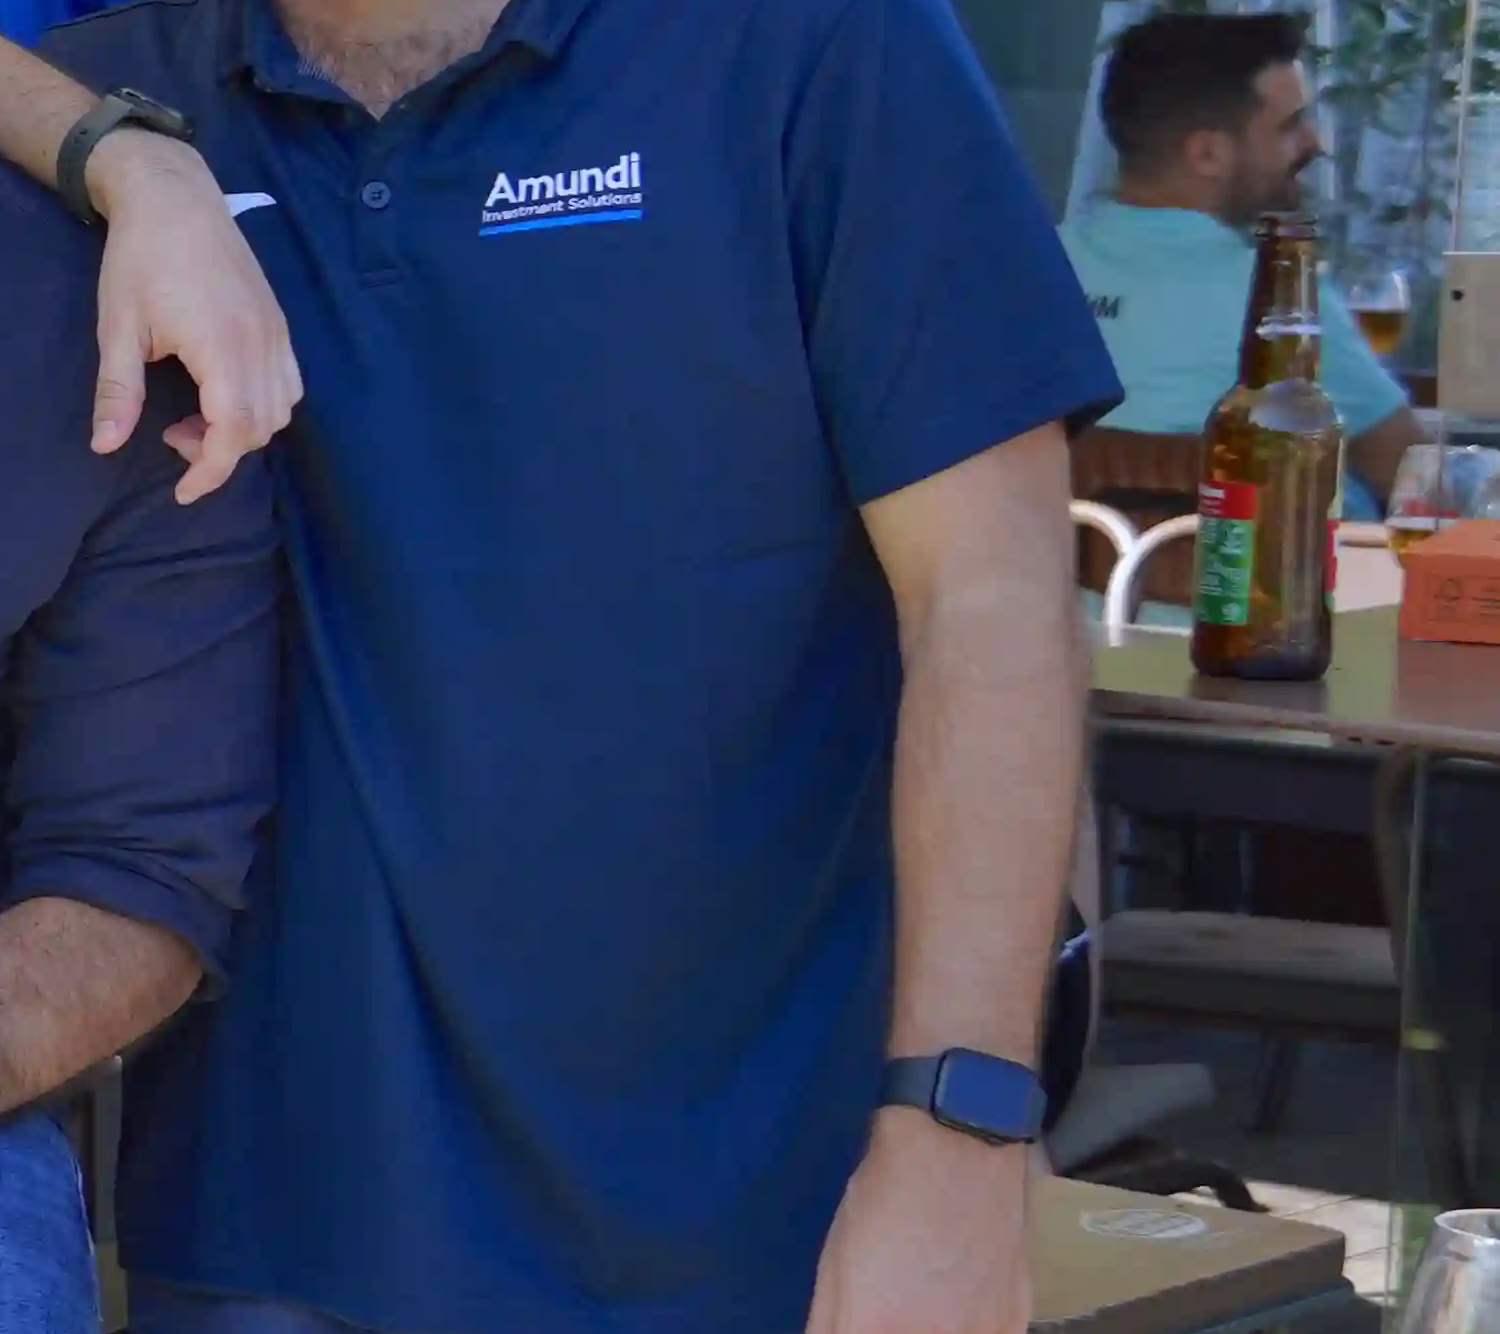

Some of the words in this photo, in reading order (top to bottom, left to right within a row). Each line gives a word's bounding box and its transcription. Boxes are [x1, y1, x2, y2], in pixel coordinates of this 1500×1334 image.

[485, 152, 641, 207] Amundi
[482, 200, 564, 222] Investment
[568, 193, 642, 210] Solutions
